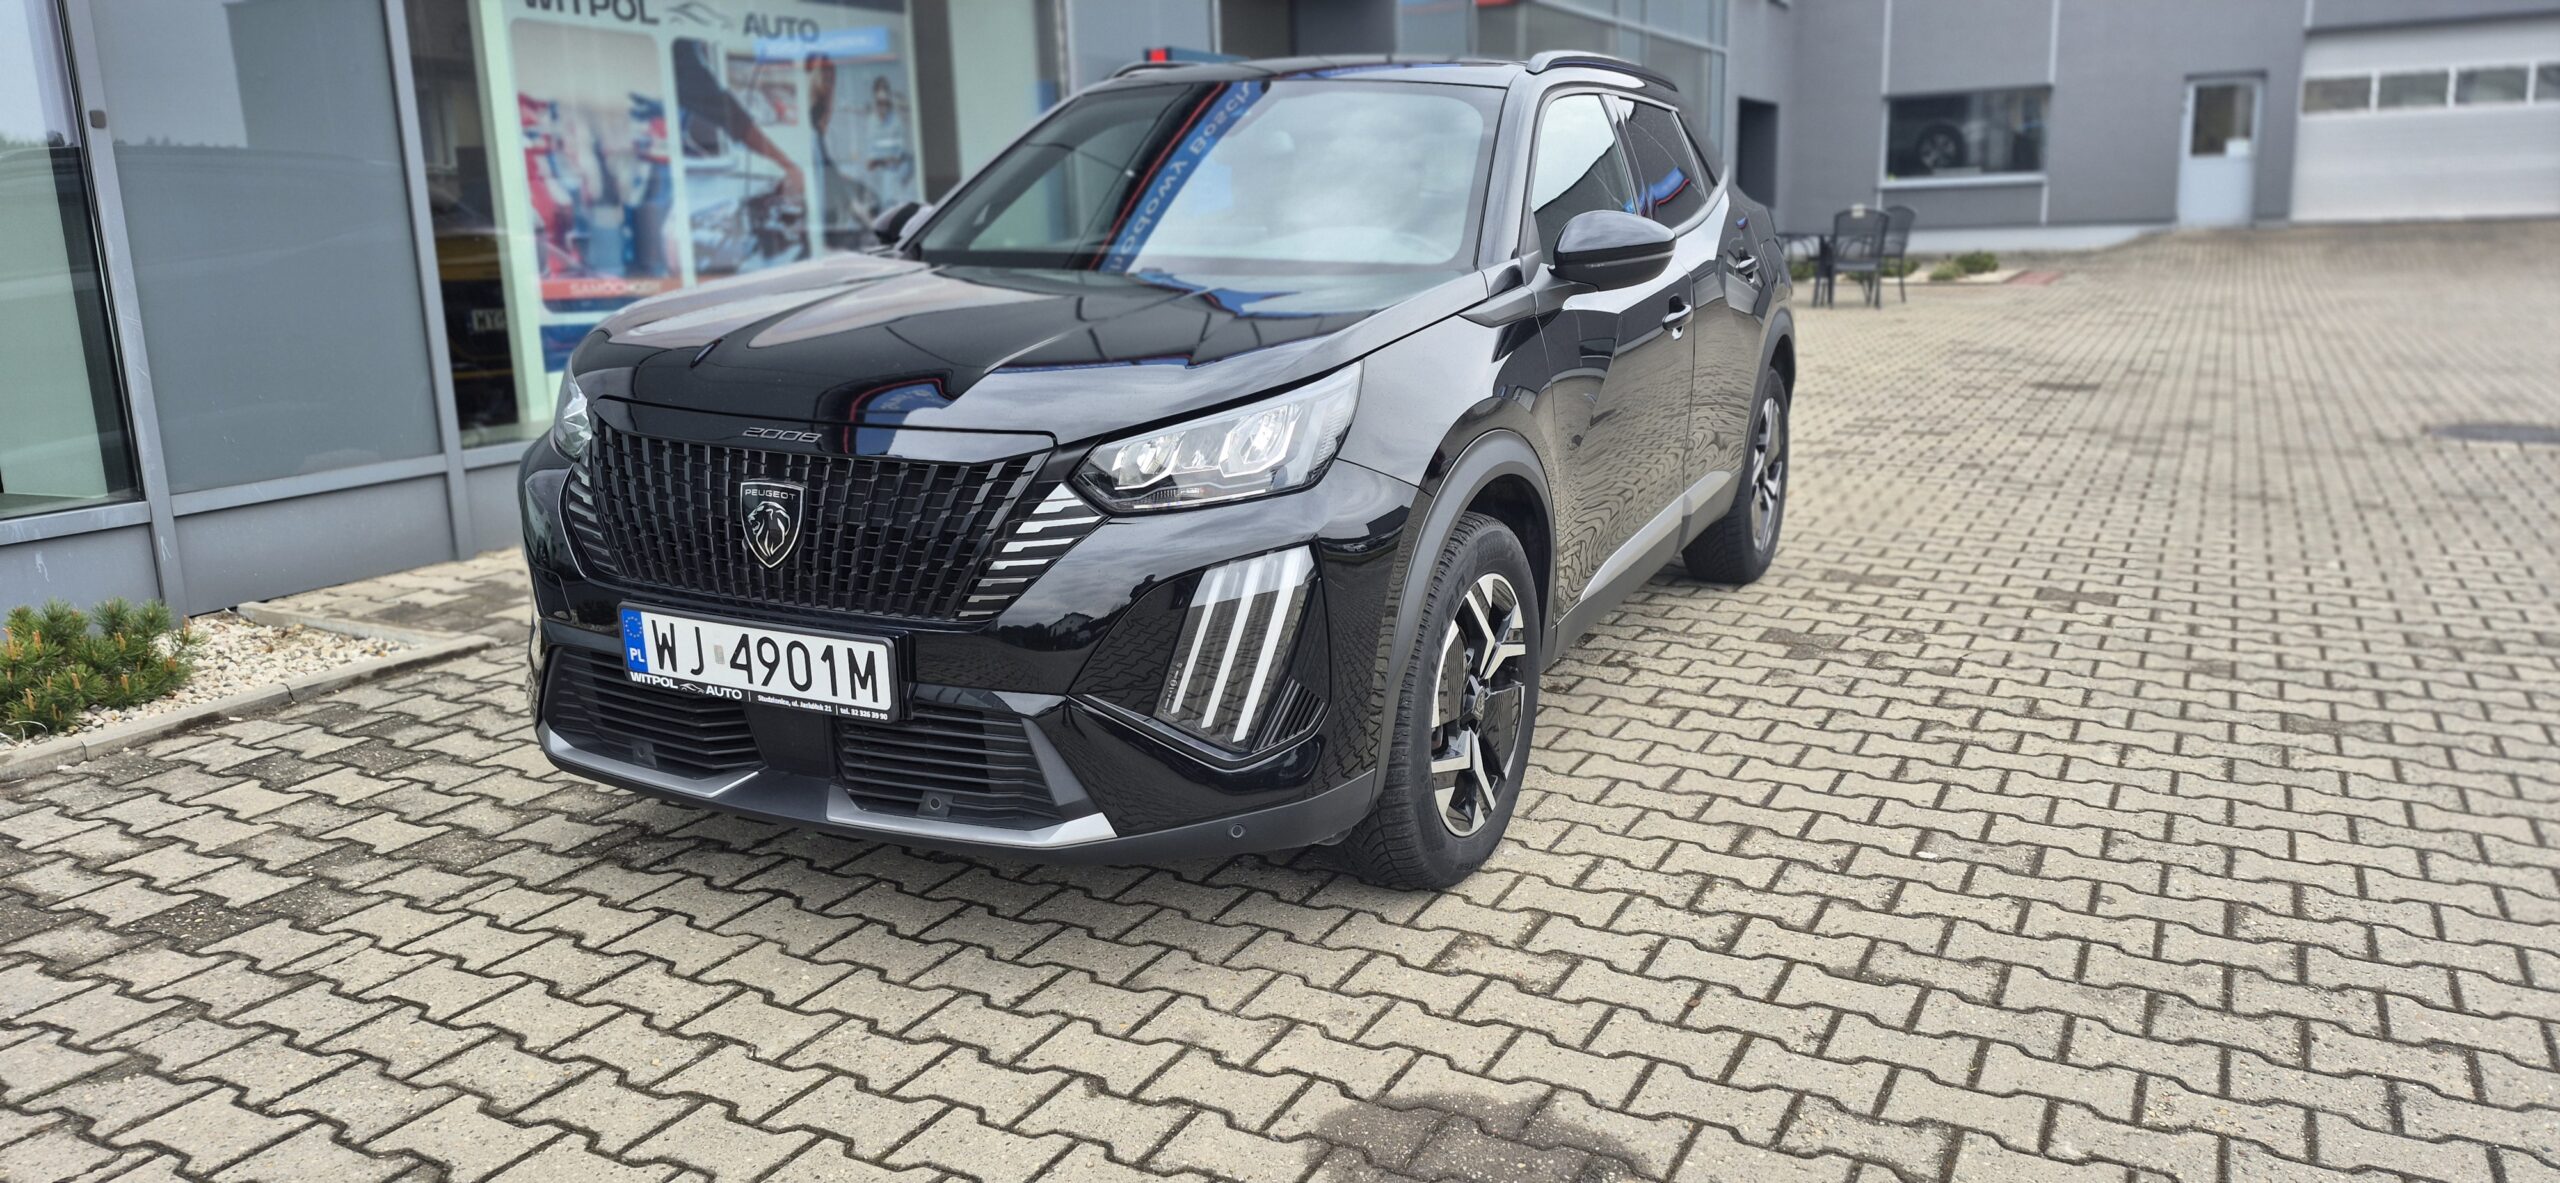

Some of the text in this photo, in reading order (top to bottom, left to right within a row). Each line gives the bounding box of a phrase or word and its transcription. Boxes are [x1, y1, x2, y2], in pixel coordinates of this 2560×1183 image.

[743, 12, 820, 43] AUTO
[742, 427, 822, 443] 2008
[745, 488, 796, 500] PEUGEOT
[629, 647, 645, 663] PL
[651, 619, 879, 703] WJ 4901M
[630, 671, 743, 700] WITPOL AUTO
[824, 704, 833, 712] 21
[840, 707, 851, 715] tel.
[879, 712, 889, 721] 90
